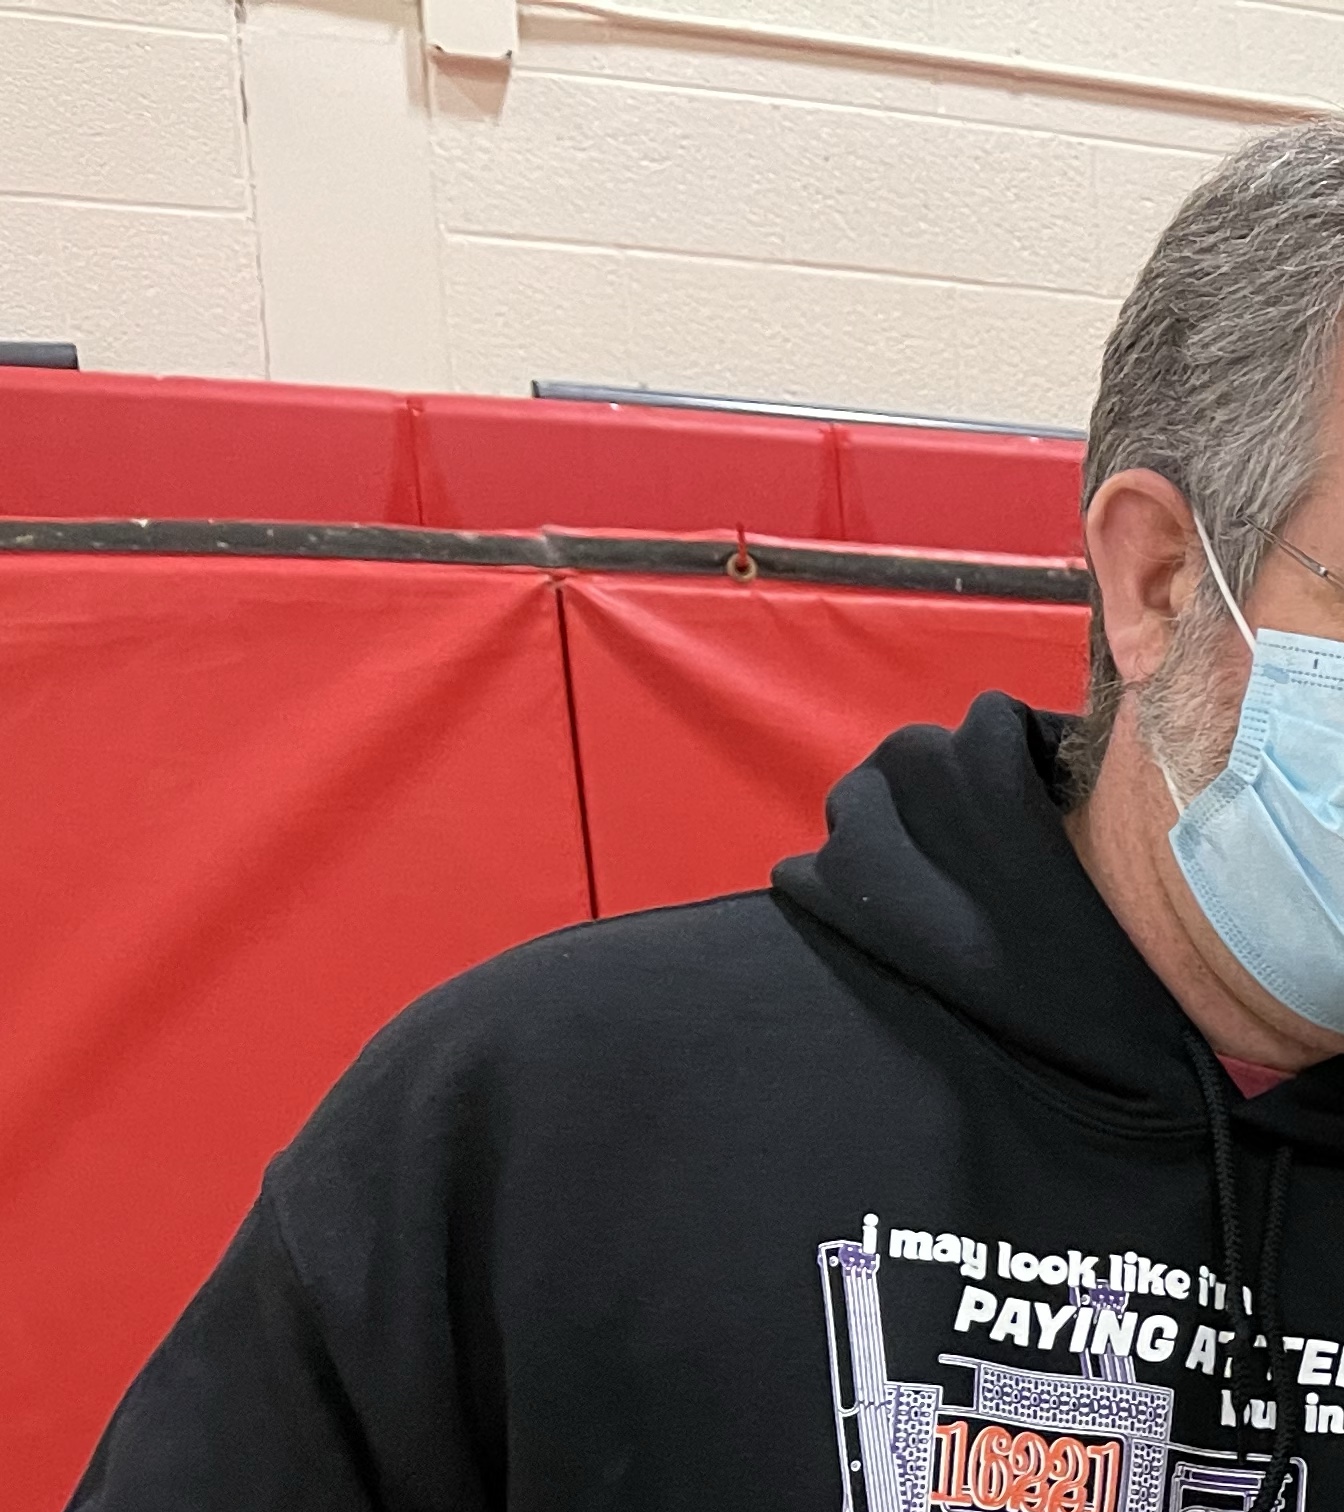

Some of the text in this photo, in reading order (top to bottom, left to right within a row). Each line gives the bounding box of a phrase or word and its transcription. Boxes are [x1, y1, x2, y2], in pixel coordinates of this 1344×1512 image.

[862, 1213, 879, 1255] i
[889, 1228, 988, 1280] may
[998, 1241, 1099, 1288] look
[1108, 1251, 1191, 1300] like
[953, 1285, 1180, 1363] PAYING
